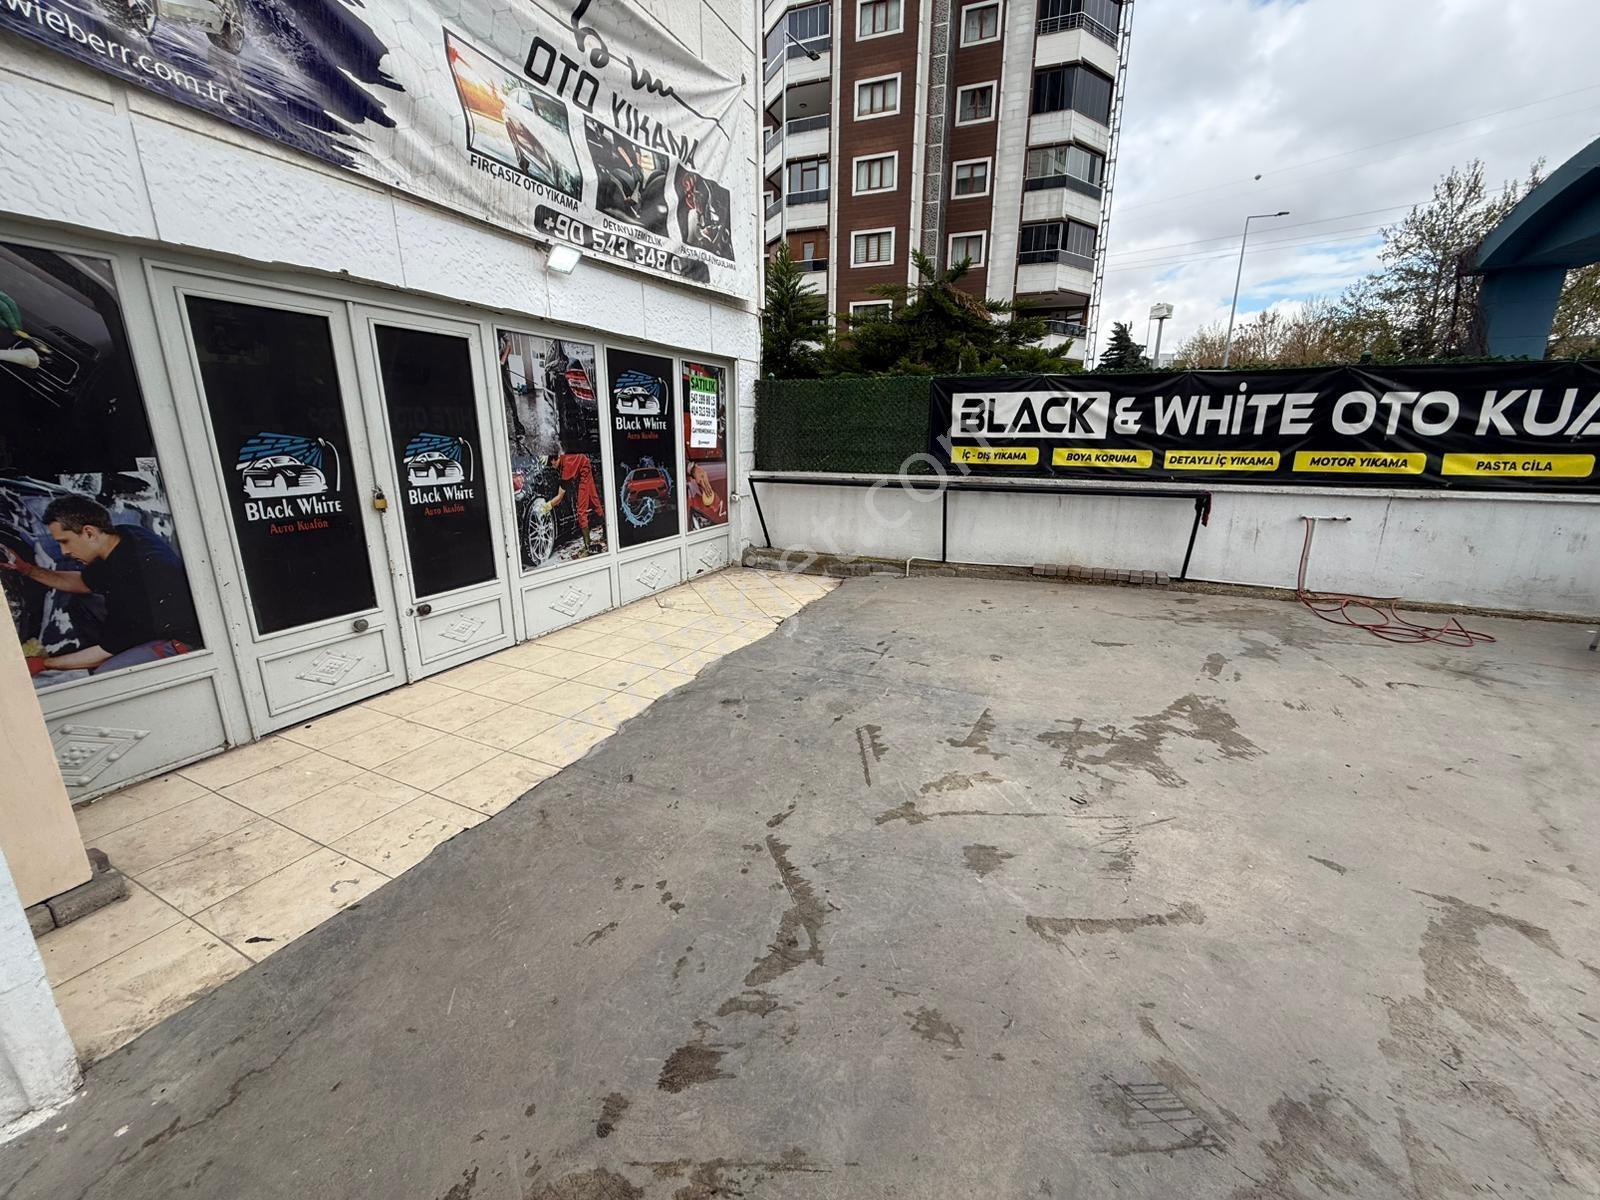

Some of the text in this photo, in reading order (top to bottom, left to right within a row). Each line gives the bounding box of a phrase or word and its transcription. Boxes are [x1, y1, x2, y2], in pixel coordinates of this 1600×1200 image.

[523, 36, 699, 169] OTO YIKAMA
[470, 154, 579, 212] FIRÇASIZ OTO YIKAMA
[543, 213, 584, 244] +90
[592, 229, 628, 259] 543
[635, 243, 668, 271] 348
[690, 377, 716, 392] SATILIK
[960, 396, 1098, 434] BLACK
[1112, 397, 1143, 436] &
[1154, 382, 1319, 436] WHİTE
[1332, 390, 1460, 437] OTO
[615, 416, 667, 430] Black White
[993, 451, 1028, 461] YIKAMA
[1066, 453, 1138, 464] BOYA KORUMA
[1168, 453, 1274, 468] DETAYLI İÇ YIKAMA
[1309, 456, 1409, 468] MOTOR YIKAMA
[1475, 458, 1552, 471] PASTA CİLA
[408, 484, 474, 505] Black White
[246, 494, 343, 522] Black White
[424, 506, 442, 517] Auto
[270, 522, 294, 535] Auto
